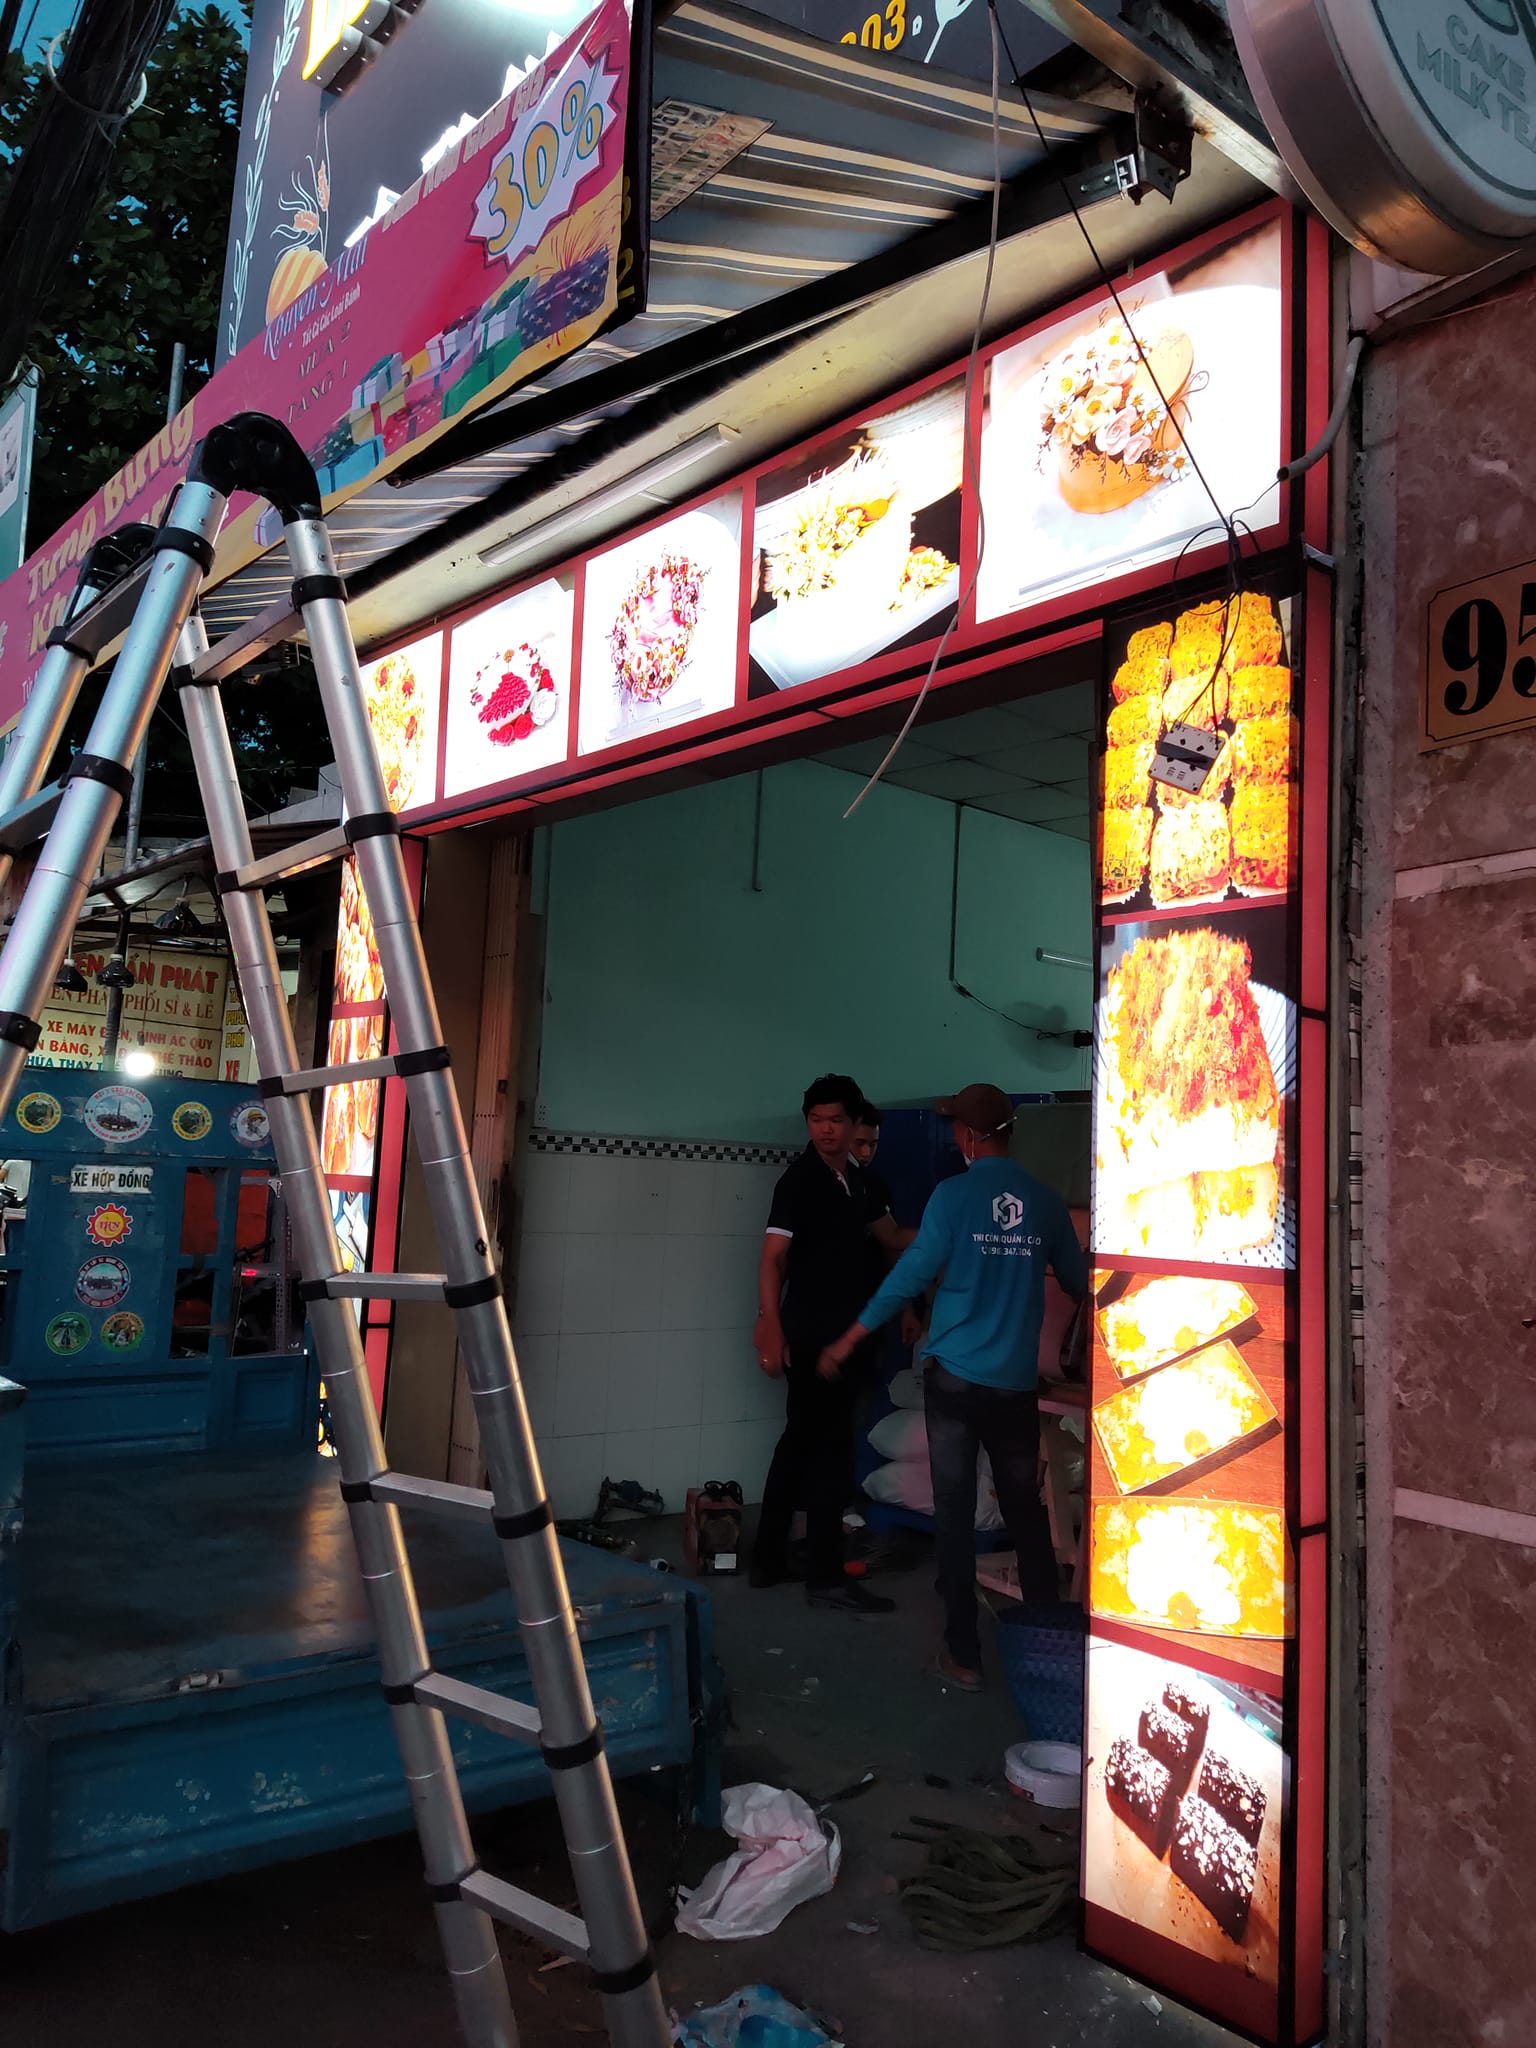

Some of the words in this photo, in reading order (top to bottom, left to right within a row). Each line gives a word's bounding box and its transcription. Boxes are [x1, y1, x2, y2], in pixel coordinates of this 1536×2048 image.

[1446, 14, 1526, 103] CAKE
[1416, 30, 1491, 120] MILK
[487, 59, 604, 256] 30%
[159, 963, 219, 995] PHÁT
[124, 988, 160, 1013] PHỐI
[182, 1001, 192, 1017] &
[47, 1020, 63, 1033] XE
[189, 1037, 214, 1052] QUY
[59, 1058, 92, 1070] THAY
[178, 1053, 214, 1069] THAO
[226, 1060, 240, 1082] XE
[73, 1172, 89, 1187] XE
[972, 1232, 984, 1243] THI
